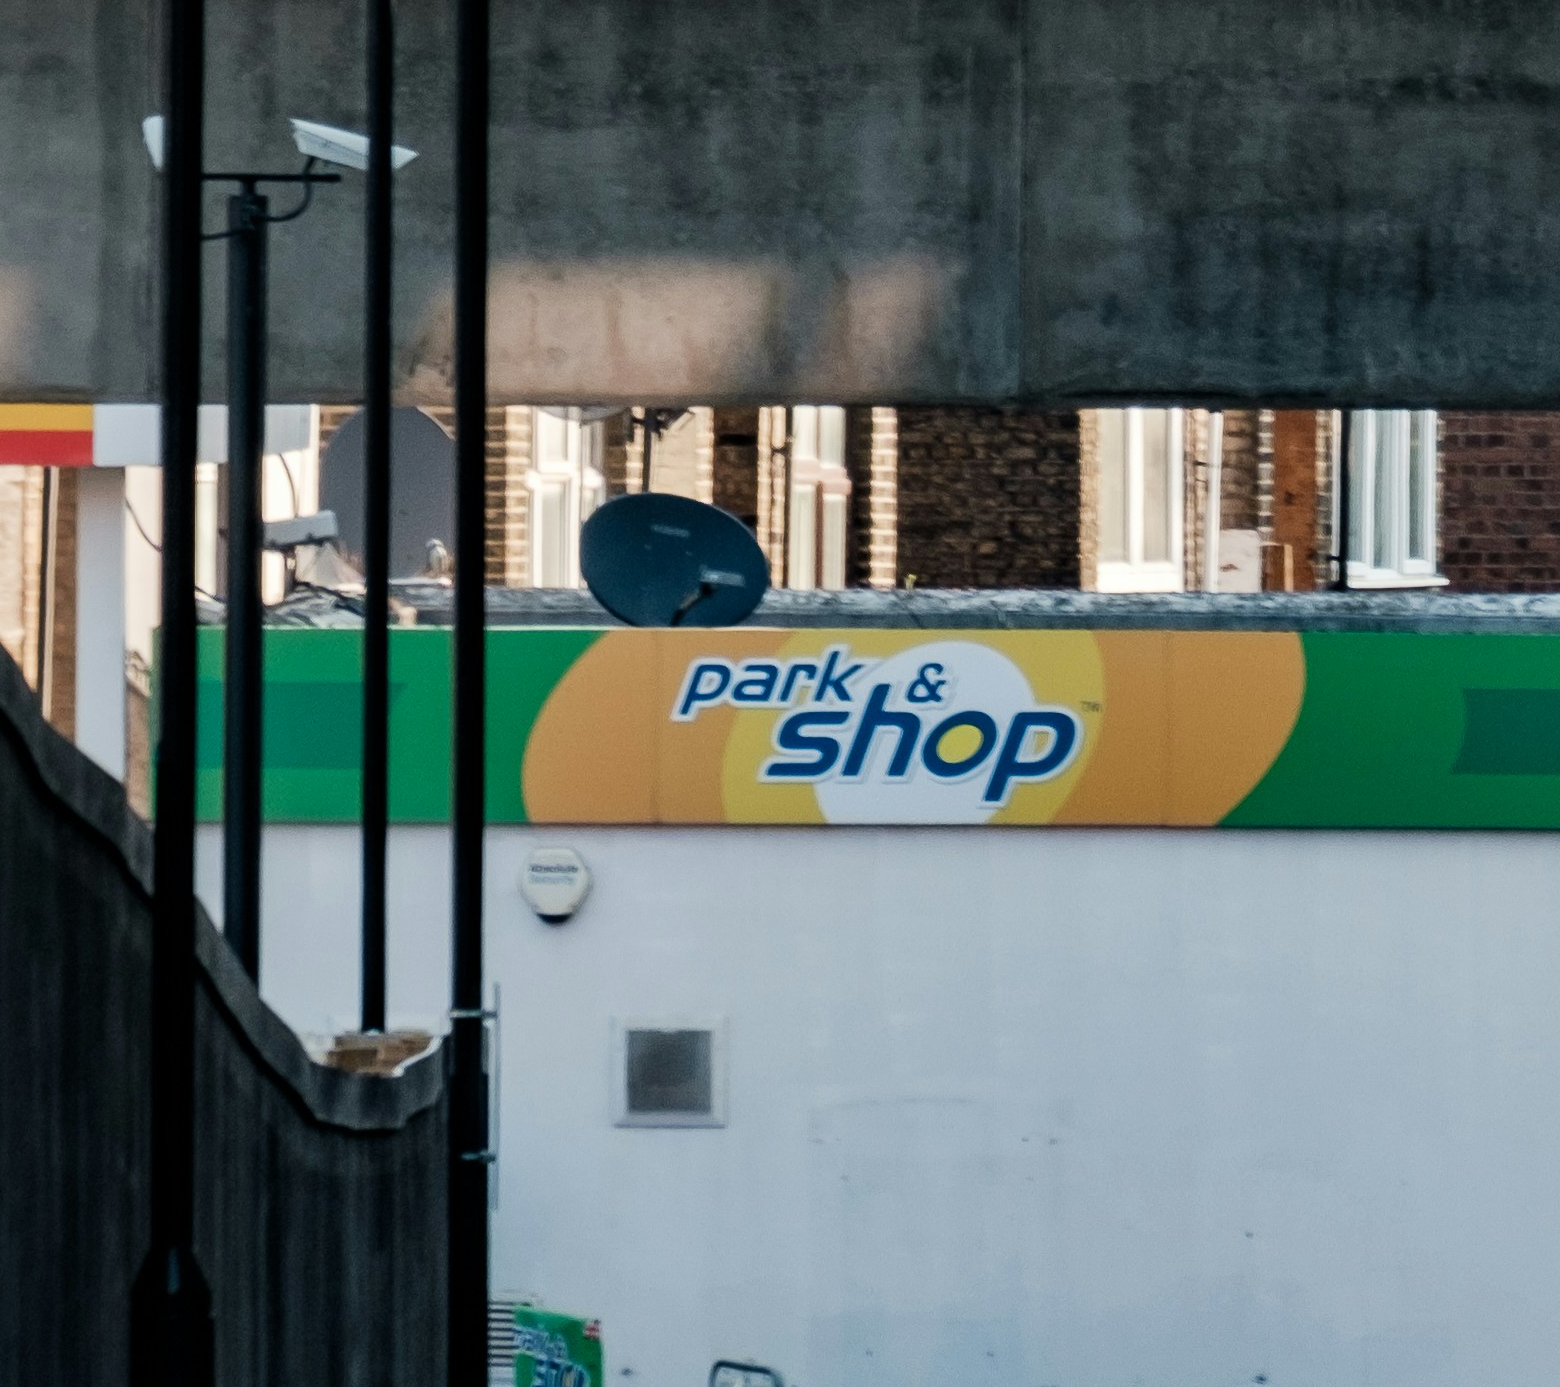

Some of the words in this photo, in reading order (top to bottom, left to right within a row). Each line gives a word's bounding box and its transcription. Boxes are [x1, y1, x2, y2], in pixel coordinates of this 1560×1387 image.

[679, 650, 867, 716] park
[906, 662, 946, 704] &
[766, 682, 1076, 802] shop
